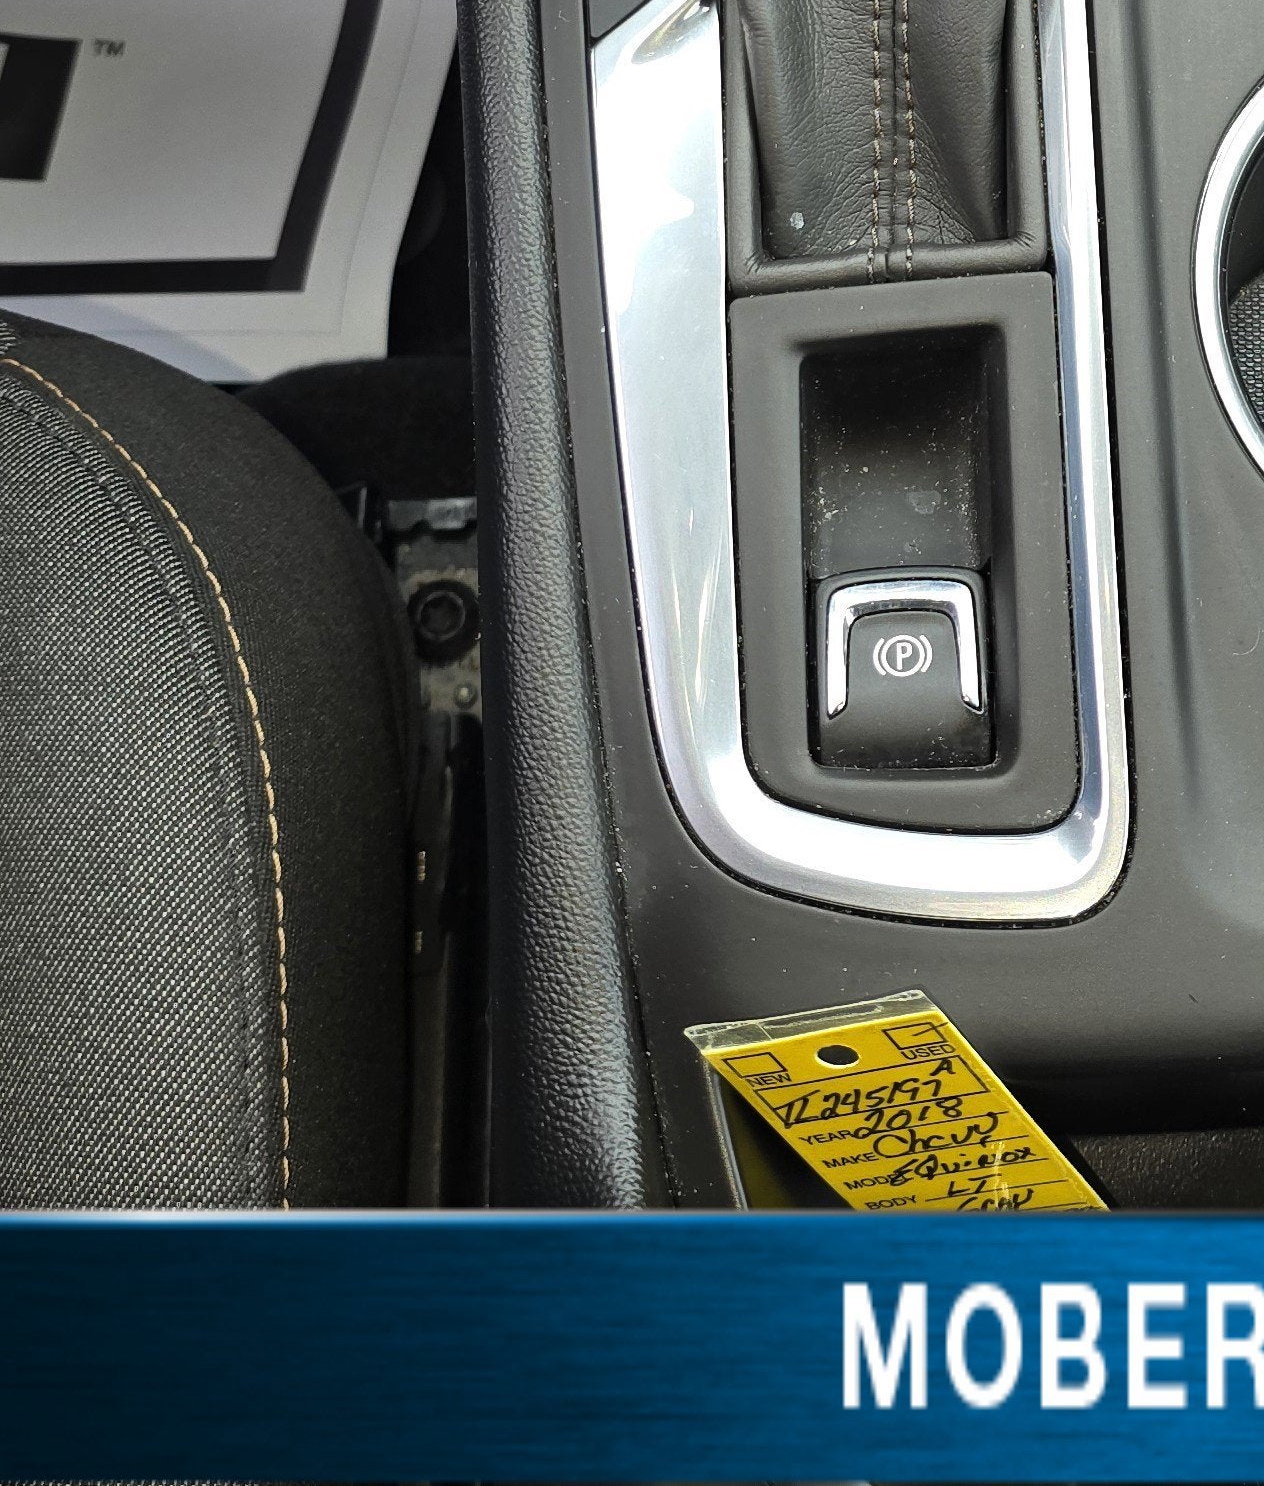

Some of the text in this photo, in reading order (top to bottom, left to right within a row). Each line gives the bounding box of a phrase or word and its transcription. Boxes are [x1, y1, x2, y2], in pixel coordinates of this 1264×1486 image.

[899, 1043, 957, 1061] USED
[745, 1072, 793, 1088] NEW
[800, 1096, 965, 1147] YEAR 2018
[821, 1151, 880, 1170] MAKE
[864, 1194, 918, 1211] BODY
